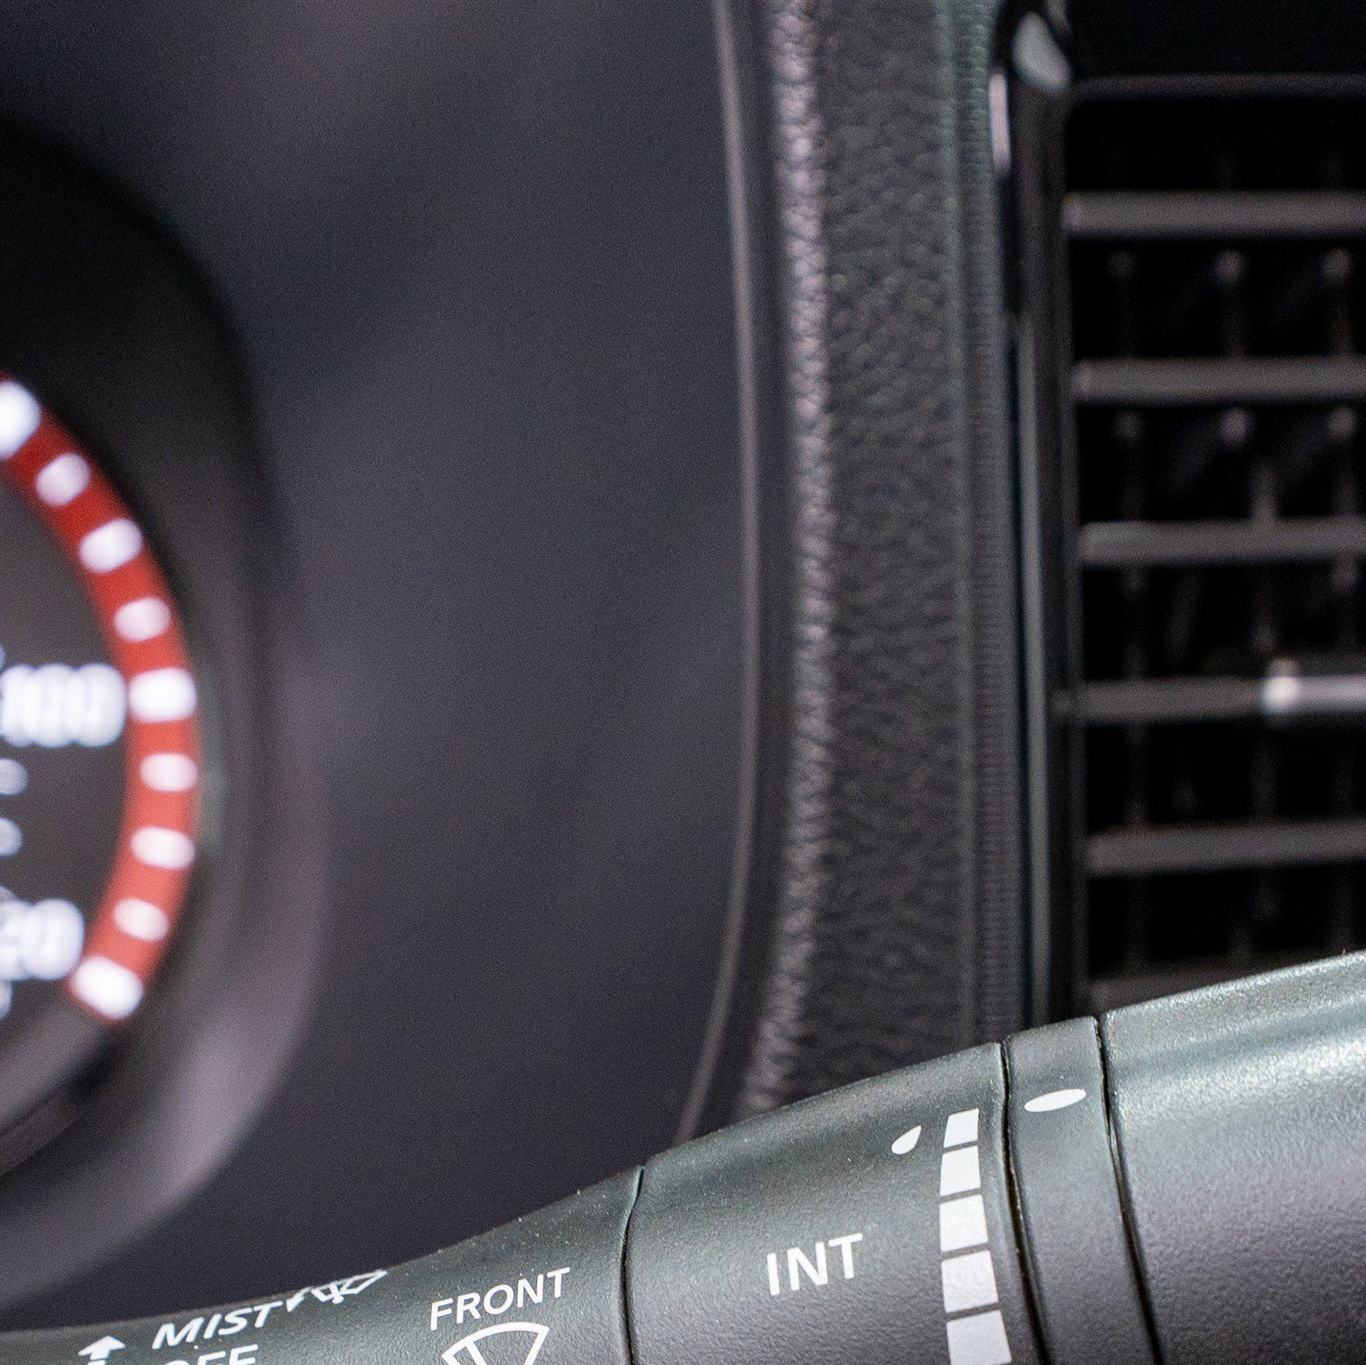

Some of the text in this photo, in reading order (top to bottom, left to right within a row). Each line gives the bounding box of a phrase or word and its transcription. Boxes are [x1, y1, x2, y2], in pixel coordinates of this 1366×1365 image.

[767, 1233, 863, 1295] INT
[151, 1300, 284, 1348] MIST
[430, 1267, 570, 1331] FRONT
